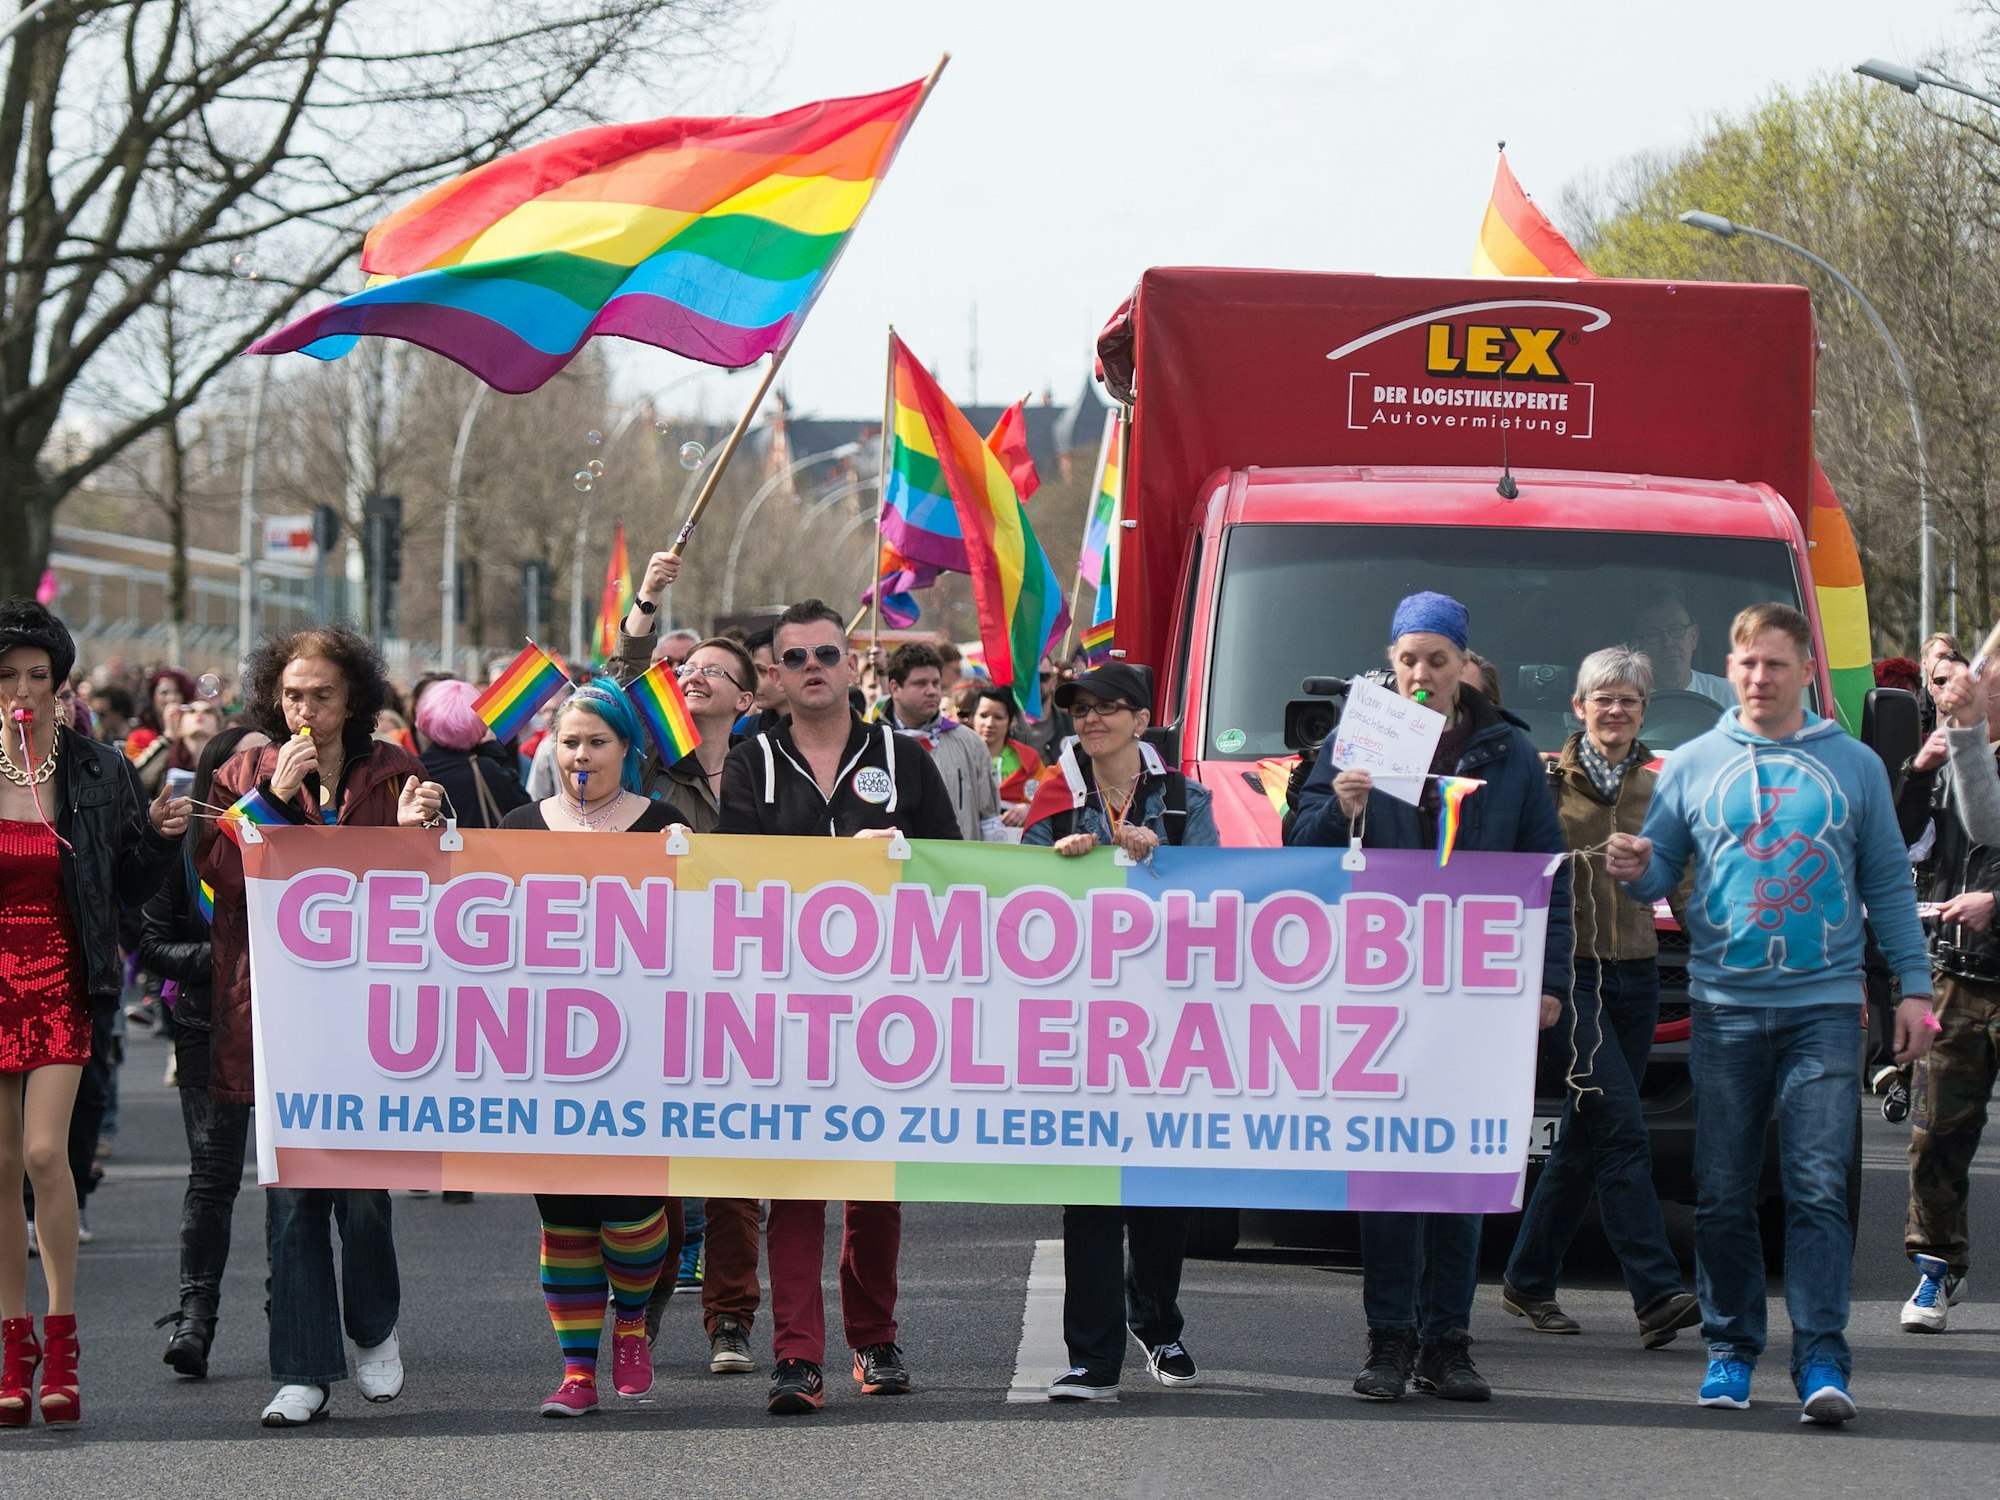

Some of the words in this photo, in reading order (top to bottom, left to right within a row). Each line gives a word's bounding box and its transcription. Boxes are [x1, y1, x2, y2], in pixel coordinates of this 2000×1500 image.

[1426, 323, 1566, 380] LEX
[1373, 385, 1408, 405] DER
[1412, 387, 1569, 411] LOGISTIKEXPERTE
[1371, 408, 1568, 435] Autovermietung
[1355, 681, 1382, 711] Wann
[1386, 700, 1407, 720] hast
[1411, 715, 1426, 731] du
[1227, 730, 1236, 741] 4
[858, 779, 888, 787] HOMO
[860, 771, 884, 779] STOP
[277, 874, 667, 969] GEGEN
[713, 885, 1517, 988] HOMOPHOBIE
[368, 984, 621, 1076] UND
[663, 991, 1400, 1093] INTOLERANZ
[276, 1093, 364, 1131] WIR
[379, 1095, 538, 1135] HABEN
[554, 1099, 646, 1138] DAS
[662, 1101, 811, 1141] RECHT
[824, 1105, 885, 1143] SO
[899, 1107, 959, 1145] ZU
[976, 1109, 1132, 1153] LEBEN,
[1147, 1112, 1230, 1149] WIE
[1244, 1114, 1331, 1151] WIR
[1347, 1116, 1456, 1154] SIND
[1470, 1119, 1508, 1155] !!!
